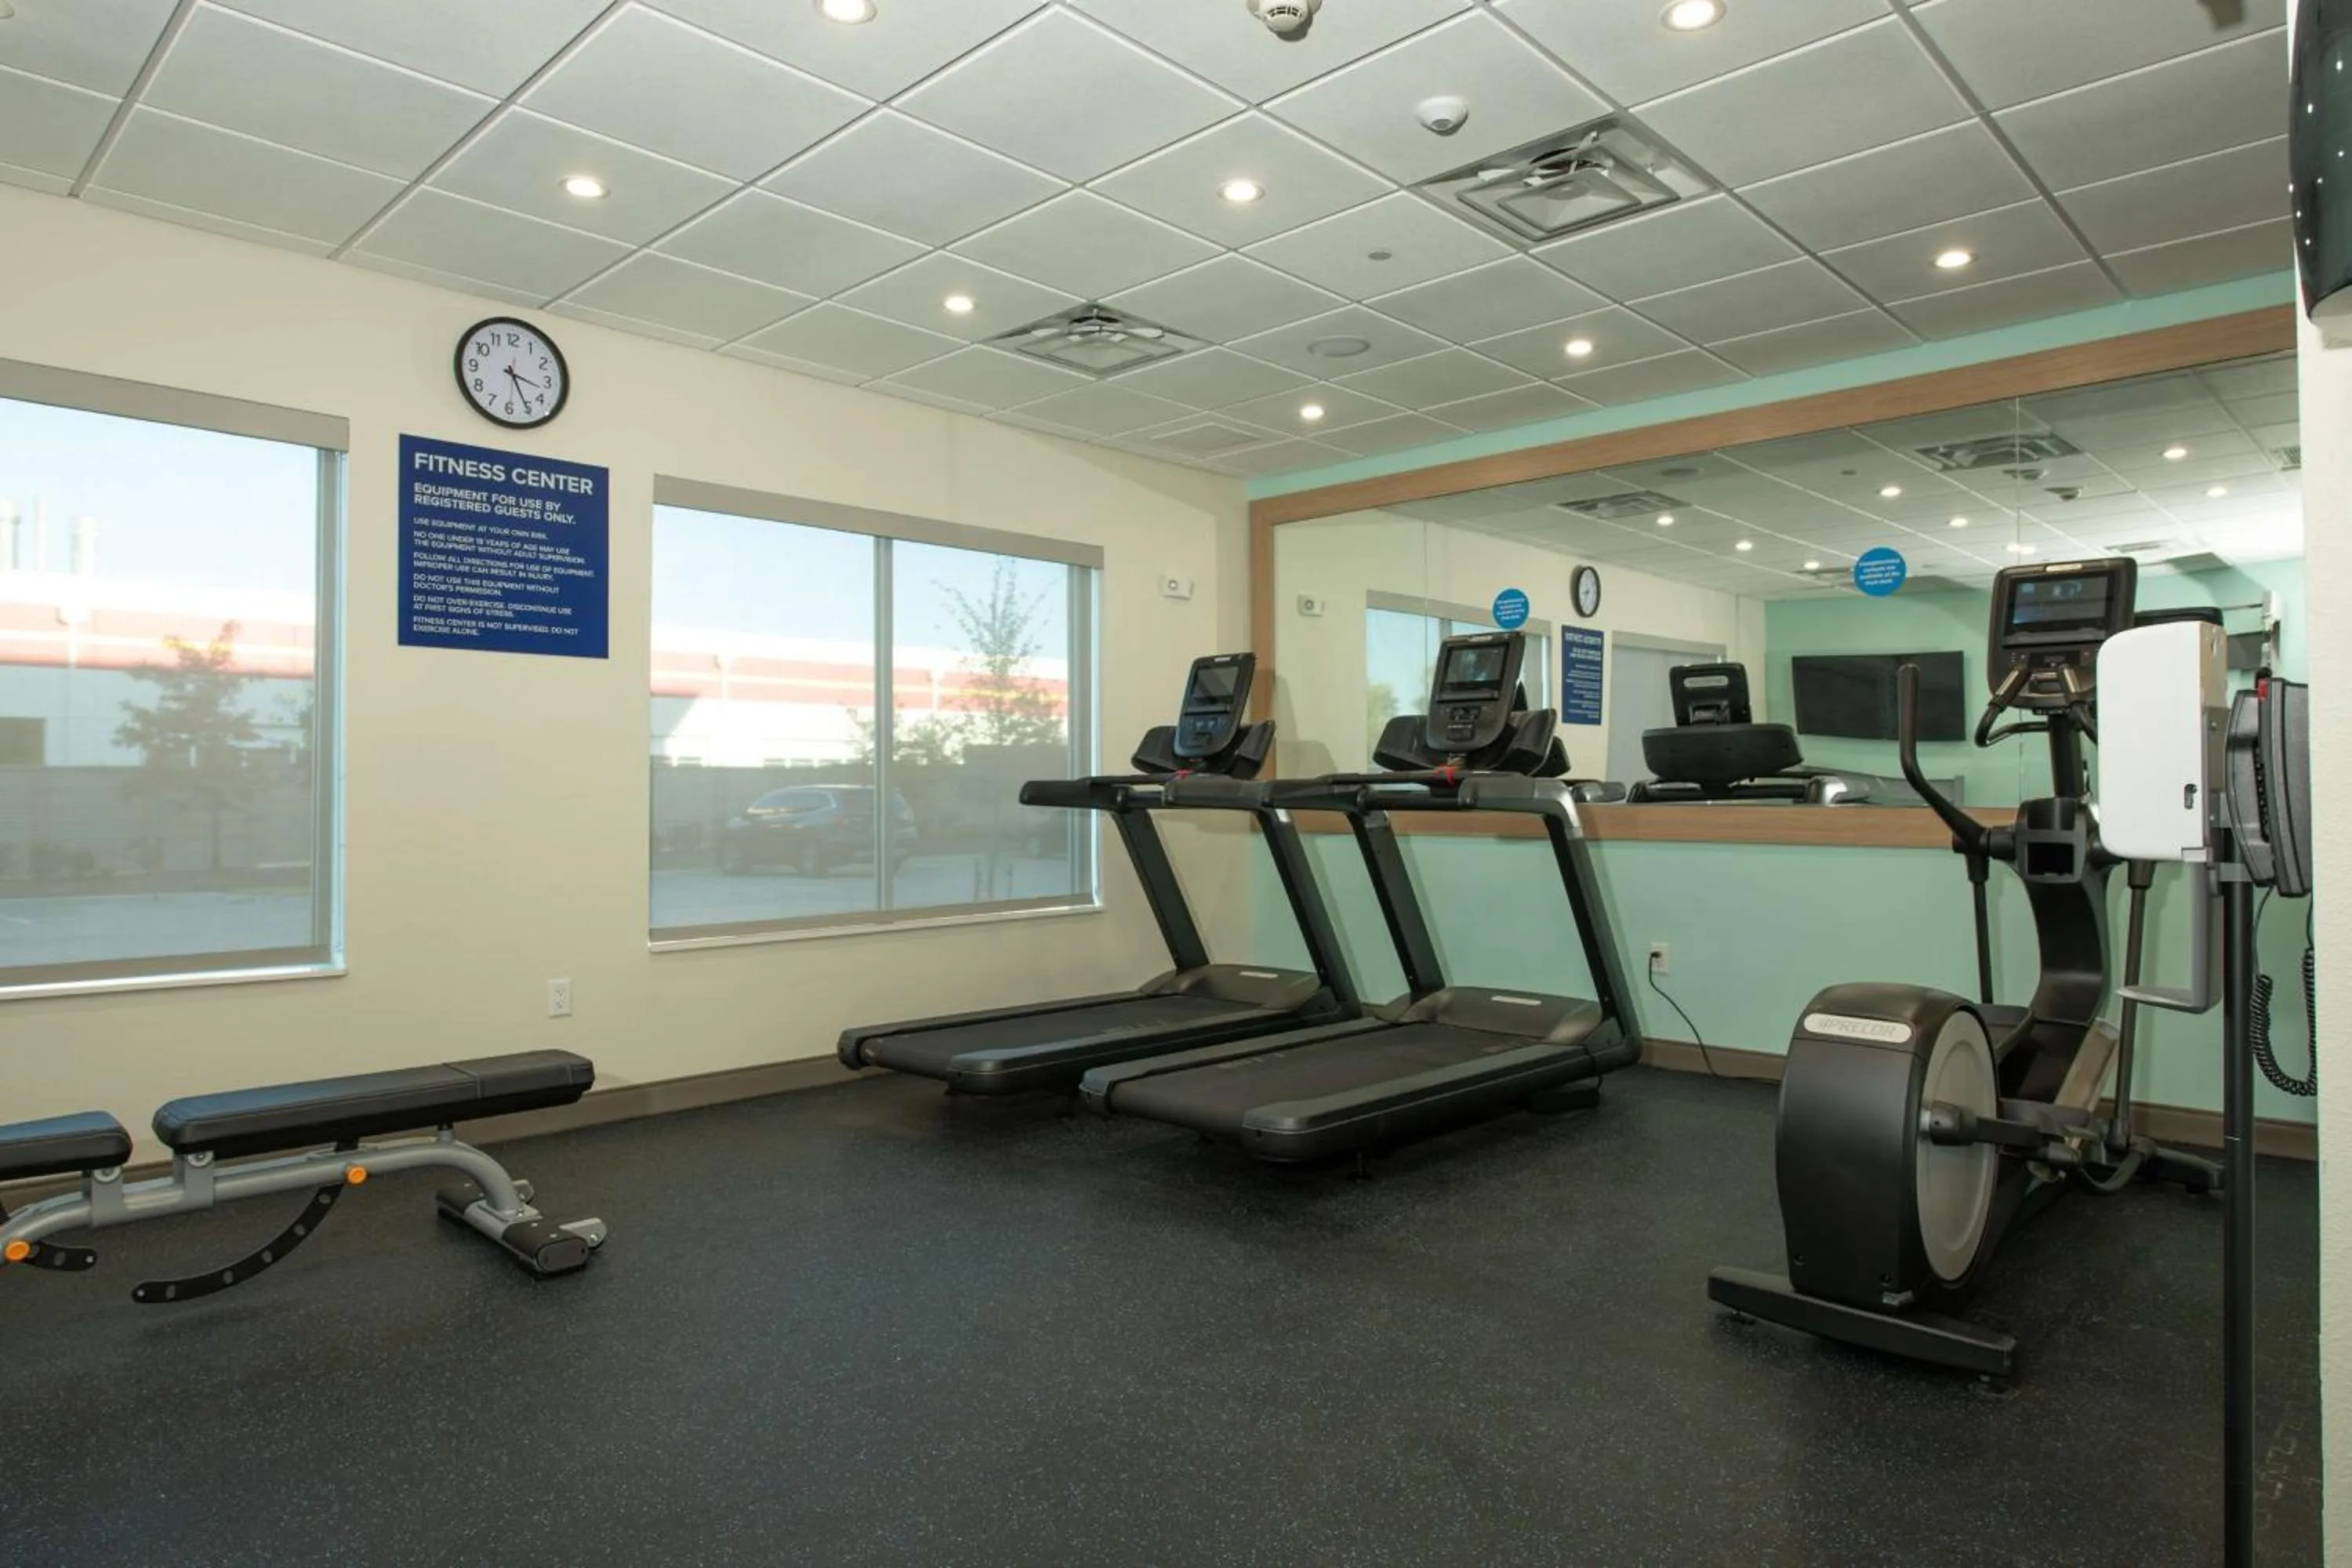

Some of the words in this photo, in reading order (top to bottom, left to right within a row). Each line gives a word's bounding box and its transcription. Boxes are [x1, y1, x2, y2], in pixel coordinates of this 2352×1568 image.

[491, 332, 501, 347] 11
[506, 332, 520, 347] 12
[476, 341, 490, 357] 10
[468, 358, 479, 372] 9
[539, 356, 549, 370] 2
[474, 378, 484, 392] 8
[543, 376, 552, 390] 3
[488, 393, 497, 406] 7
[535, 393, 544, 406] 4
[504, 401, 514, 415] 6
[524, 401, 532, 415] 5
[414, 452, 506, 482] FITNESS
[511, 467, 593, 495] CENTER
[414, 482, 488, 502] EQUIPMENT
[492, 493, 517, 506] FOR
[519, 497, 543, 510] USE
[545, 501, 561, 512] BY
[414, 493, 492, 514] REGISTERED
[494, 504, 541, 520] GUESTS
[543, 512, 576, 525] ONLY.
[413, 517, 429, 525] USE
[431, 518, 475, 531] EQUIPMENT
[488, 526, 509, 535] YOUR
[511, 528, 528, 537] OWN
[428, 532, 445, 540] ONE
[447, 534, 474, 543] UNDER
[485, 539, 508, 547] YEARS
[414, 538, 429, 546] THE
[430, 540, 475, 552] EQUIPMENT
[477, 546, 511, 556] WITHOUT
[514, 550, 536, 558] ADULT
[413, 551, 445, 561] FOLLOW
[463, 557, 507, 568] DIRECTIONS
[413, 560, 452, 570] IMPROPER
[490, 568, 516, 576] RESULT
[482, 579, 524, 590] EQUIPMENT
[526, 584, 559, 593] WITHOUT
[448, 605, 470, 614] SIGNS
[507, 603, 557, 613] DISCONTINUE
[413, 615, 444, 625] FITNESS
[446, 619, 477, 627] CENTER
[413, 624, 450, 633] EXERCISE
